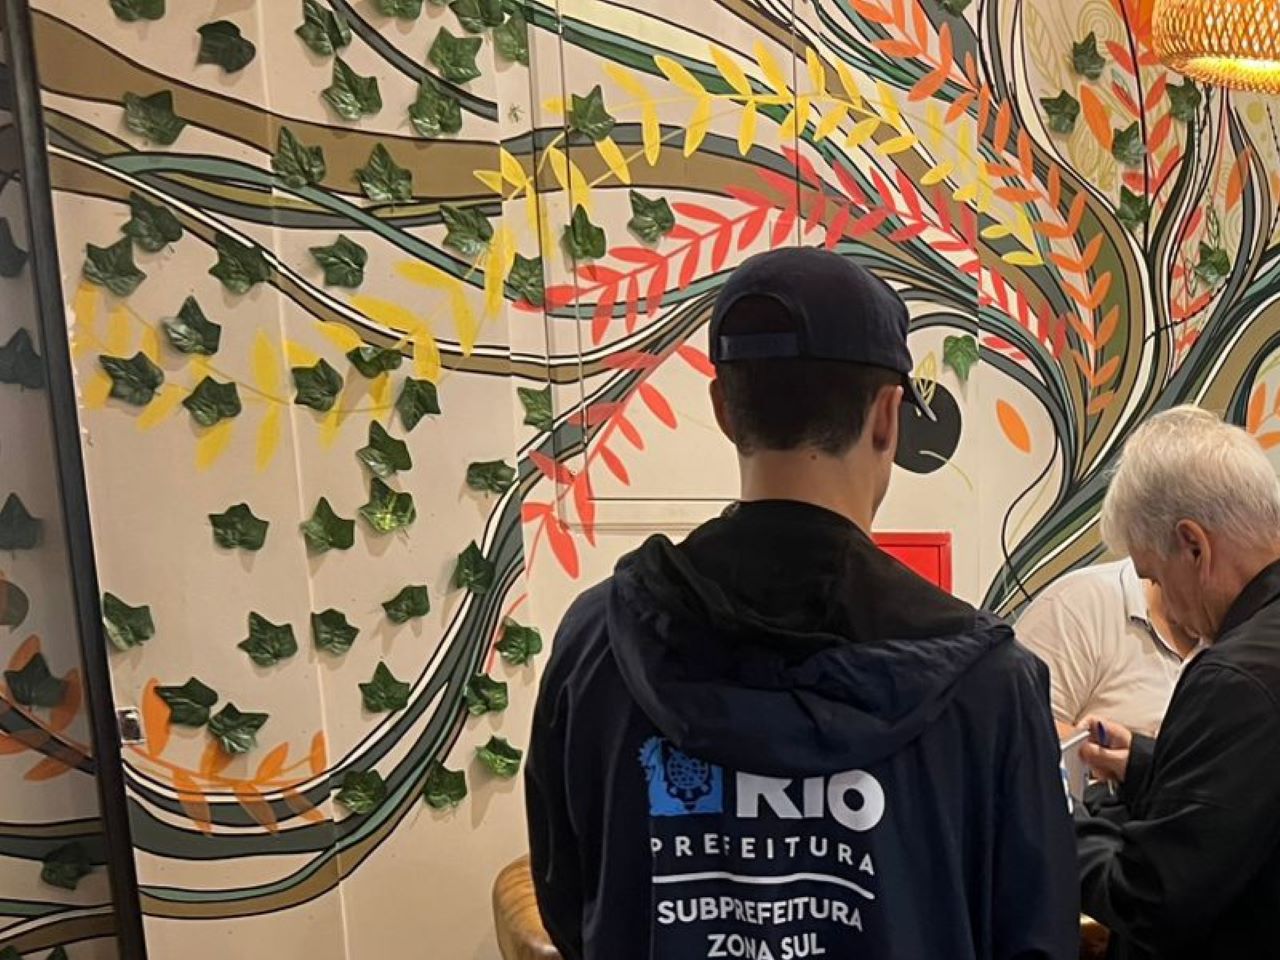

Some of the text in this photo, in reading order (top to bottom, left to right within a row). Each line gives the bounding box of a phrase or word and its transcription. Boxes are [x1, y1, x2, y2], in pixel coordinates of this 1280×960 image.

[651, 833, 875, 876] PREEITURA
[657, 896, 863, 932] SUBPREFEITURA
[781, 932, 826, 960] SUL
